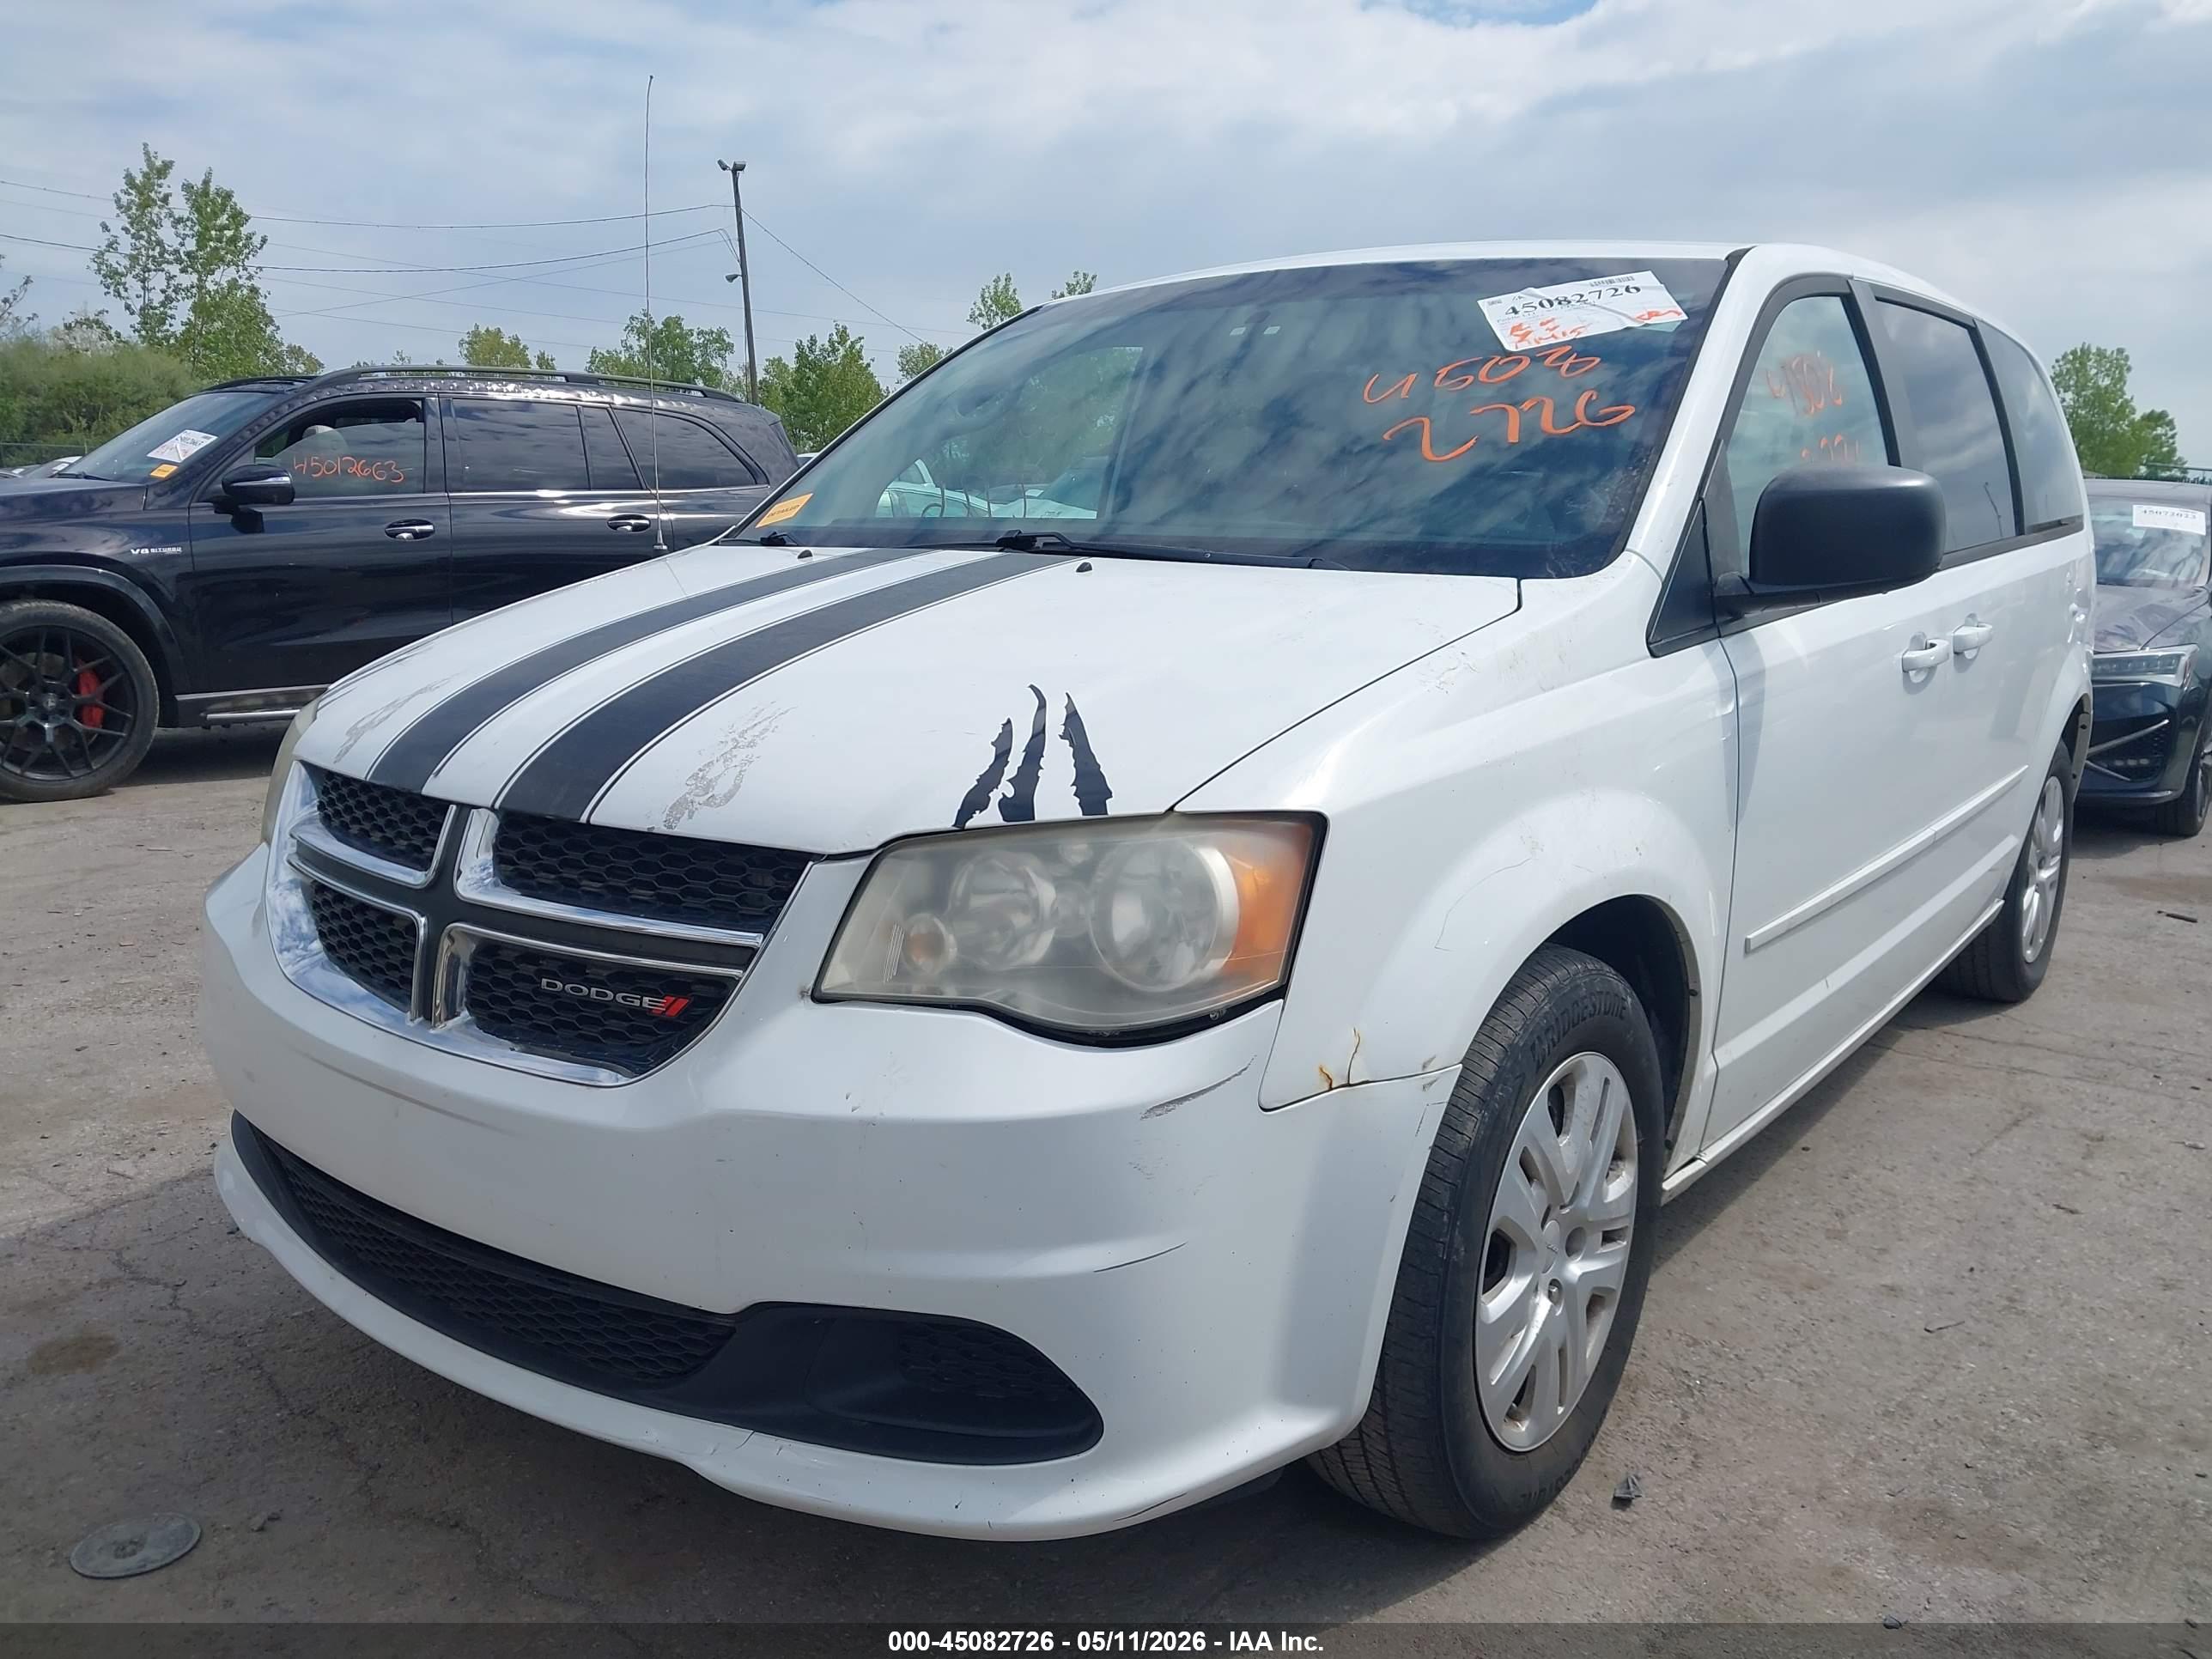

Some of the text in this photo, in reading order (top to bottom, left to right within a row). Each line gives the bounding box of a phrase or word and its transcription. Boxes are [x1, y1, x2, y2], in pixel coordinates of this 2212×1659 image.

[1504, 284, 1642, 317] 45082726
[1382, 389, 1636, 463] 2726
[293, 455, 405, 483] 45012663
[540, 977, 668, 1012] DODGE
